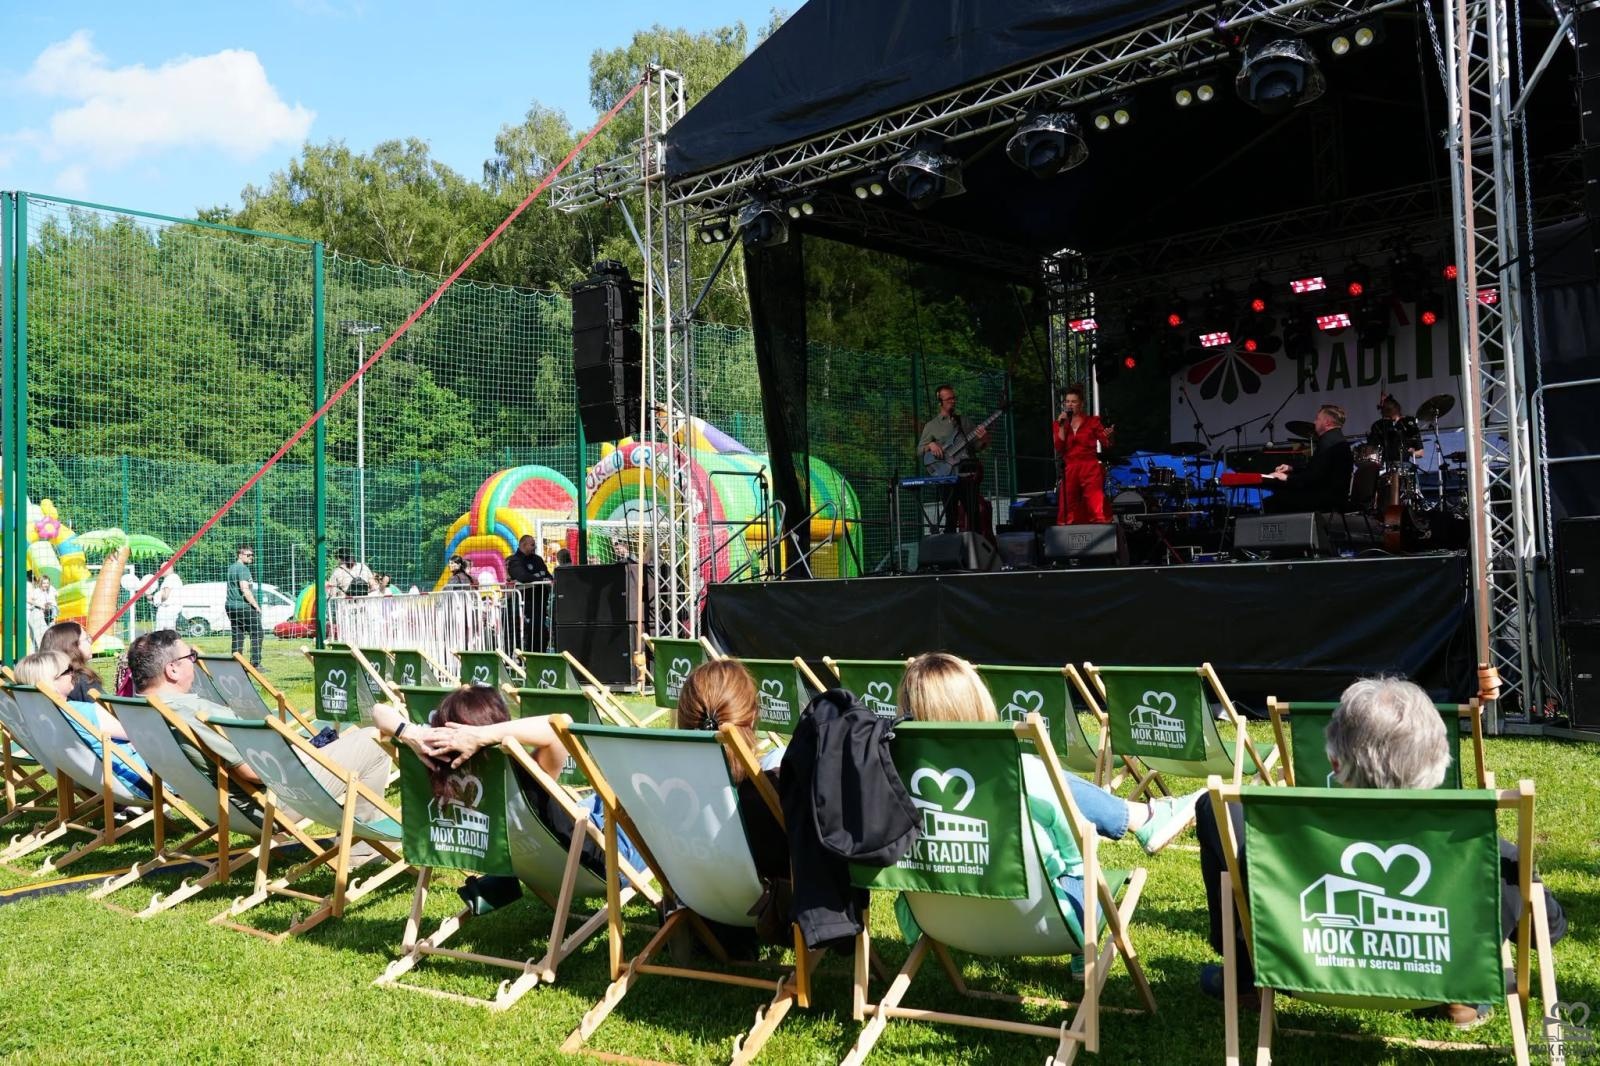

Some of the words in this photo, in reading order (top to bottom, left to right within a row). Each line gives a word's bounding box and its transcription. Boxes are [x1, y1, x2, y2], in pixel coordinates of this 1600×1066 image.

[1131, 727, 1152, 740] MOK
[1154, 730, 1187, 744] RADLIN
[430, 826, 455, 844] MOK
[457, 828, 489, 851] RADLIN
[927, 841, 990, 865] RADLIN
[933, 864, 956, 873] sercu
[957, 864, 984, 876] miasta
[1302, 927, 1356, 955] MOK
[1362, 931, 1451, 962] RADLIN
[1315, 954, 1356, 968] kultura
[1357, 958, 1367, 969] w
[1369, 959, 1400, 971] sercu
[1403, 960, 1443, 975] miasta
